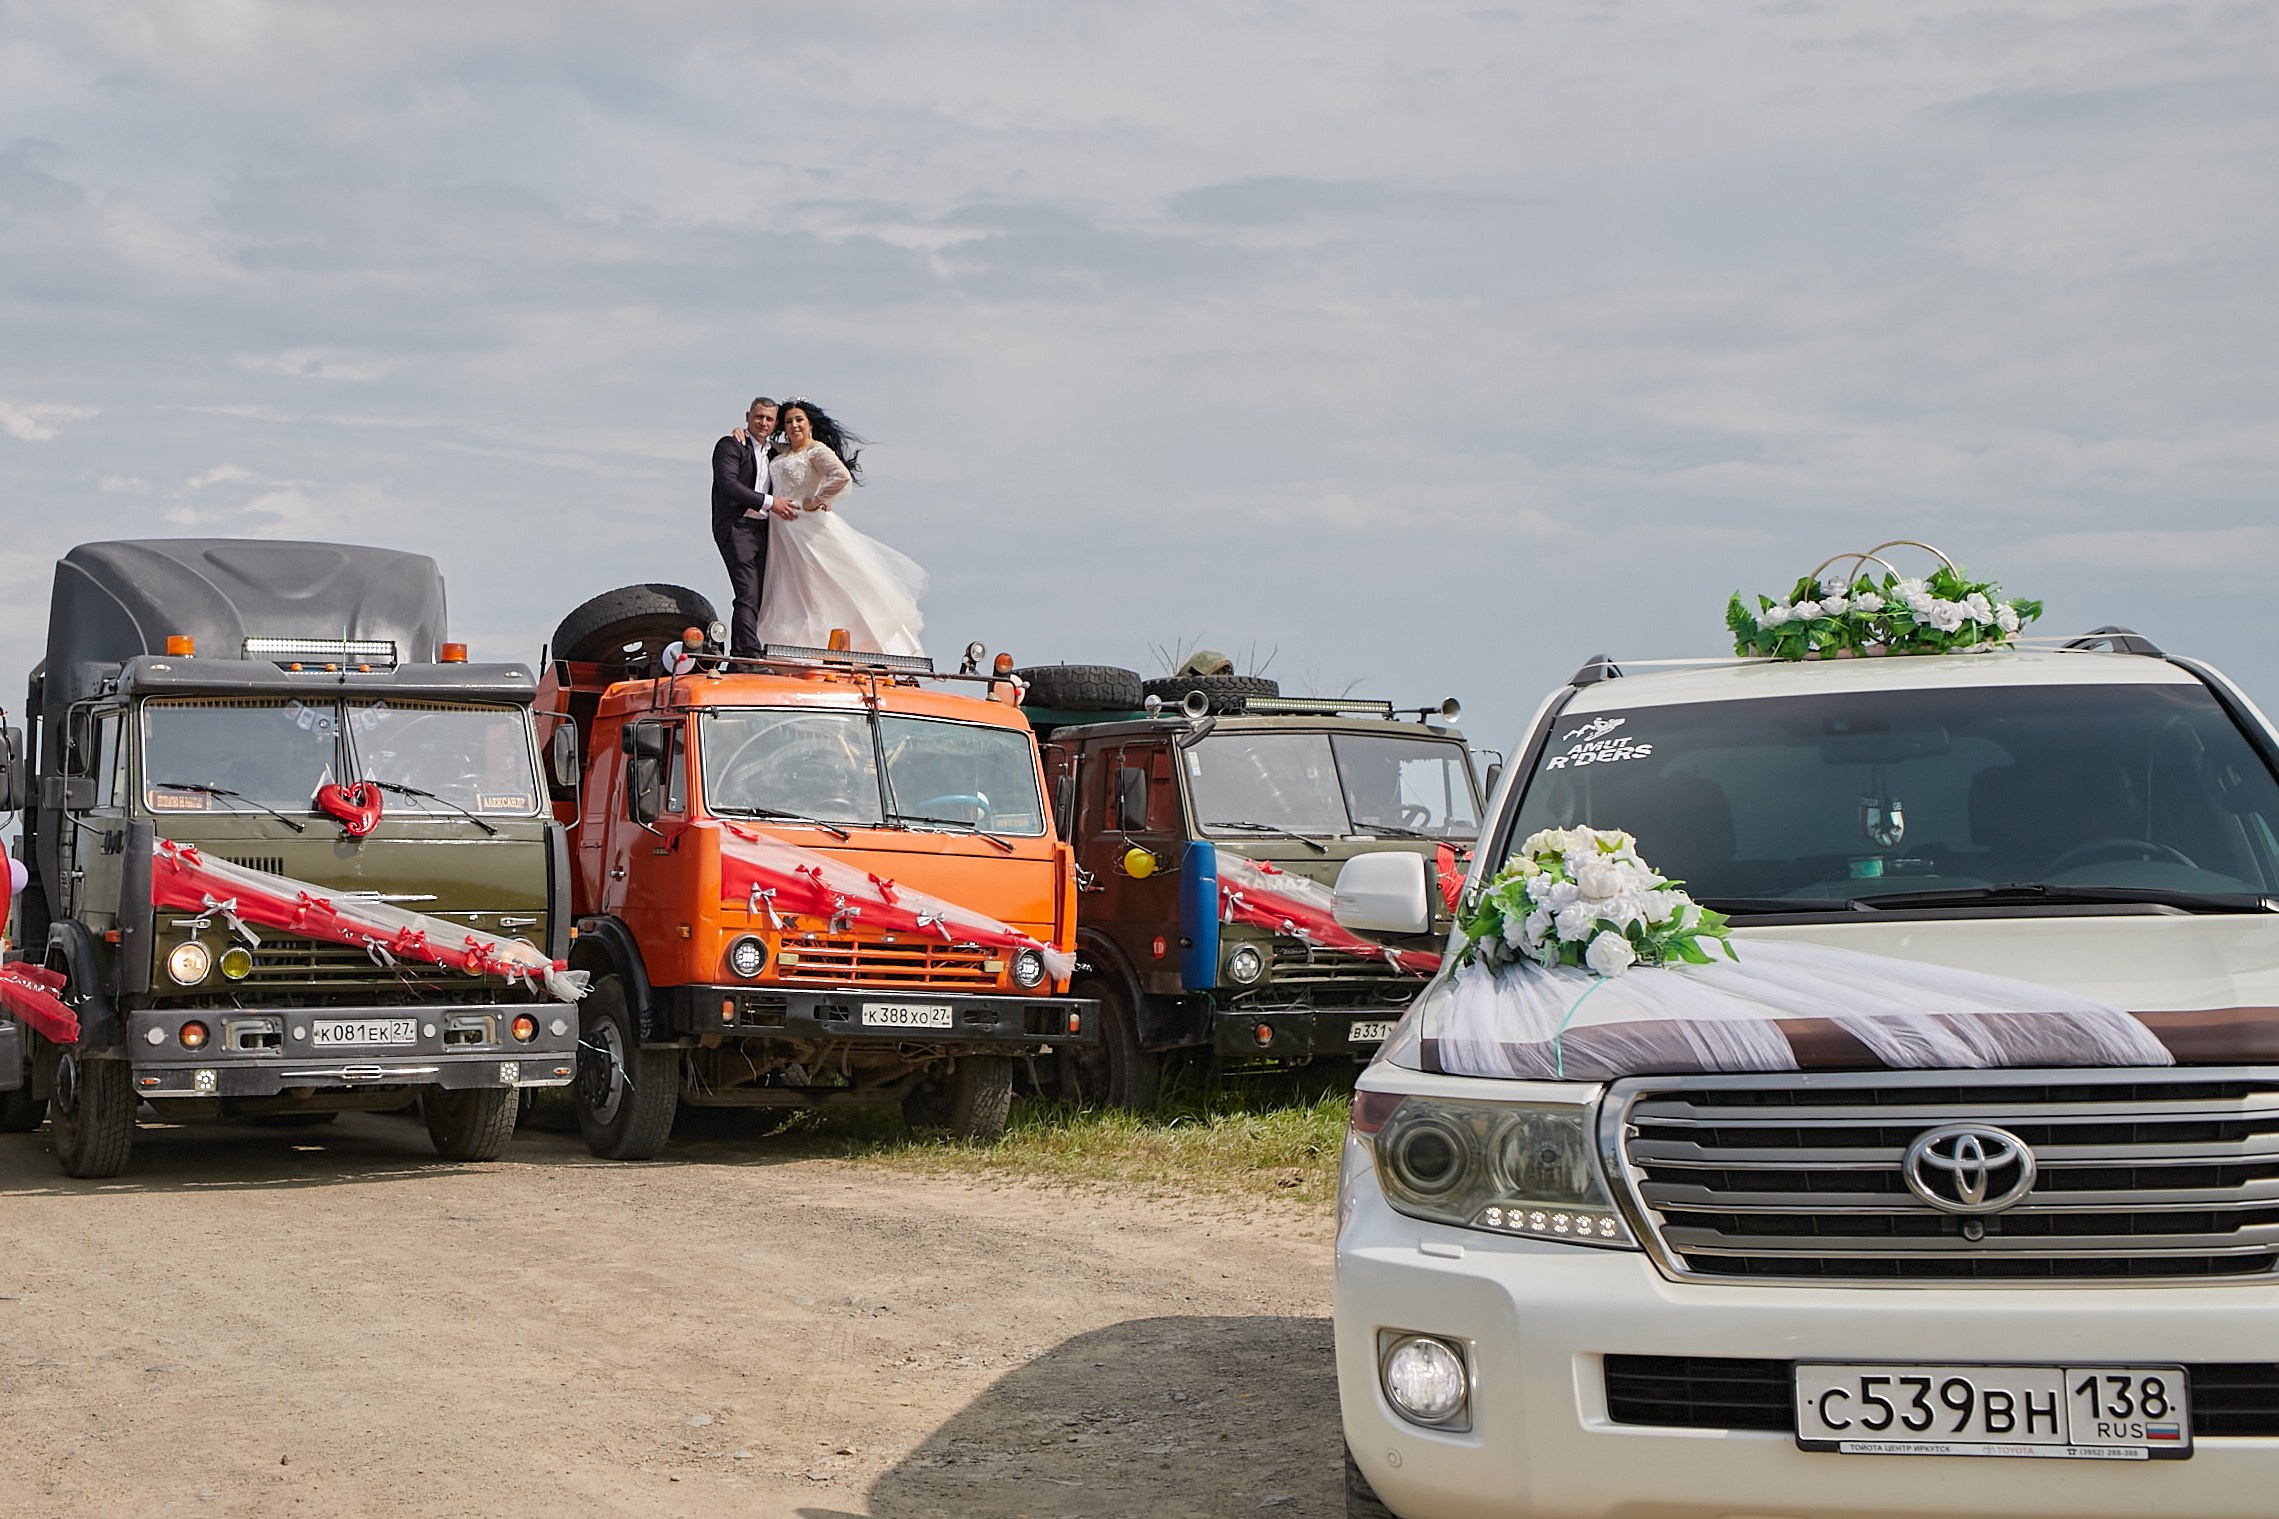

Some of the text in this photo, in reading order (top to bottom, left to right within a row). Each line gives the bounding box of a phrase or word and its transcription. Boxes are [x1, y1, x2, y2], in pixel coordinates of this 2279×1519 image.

[1567, 736, 1633, 755] AMUT
[484, 796, 526, 809] АЛЕКСАНДР
[868, 1007, 947, 1024] К388ХО 27
[321, 1022, 410, 1041] К081ЕК 27
[1353, 1024, 1392, 1039] В331
[1819, 1375, 2169, 1435] С539ВН 138
[2097, 1422, 2144, 1439] RUS
[1850, 1443, 1951, 1453] ТОЙОТА ЦЕНТР ИРКУТСК
[1998, 1447, 2034, 1455] TOYOTA
